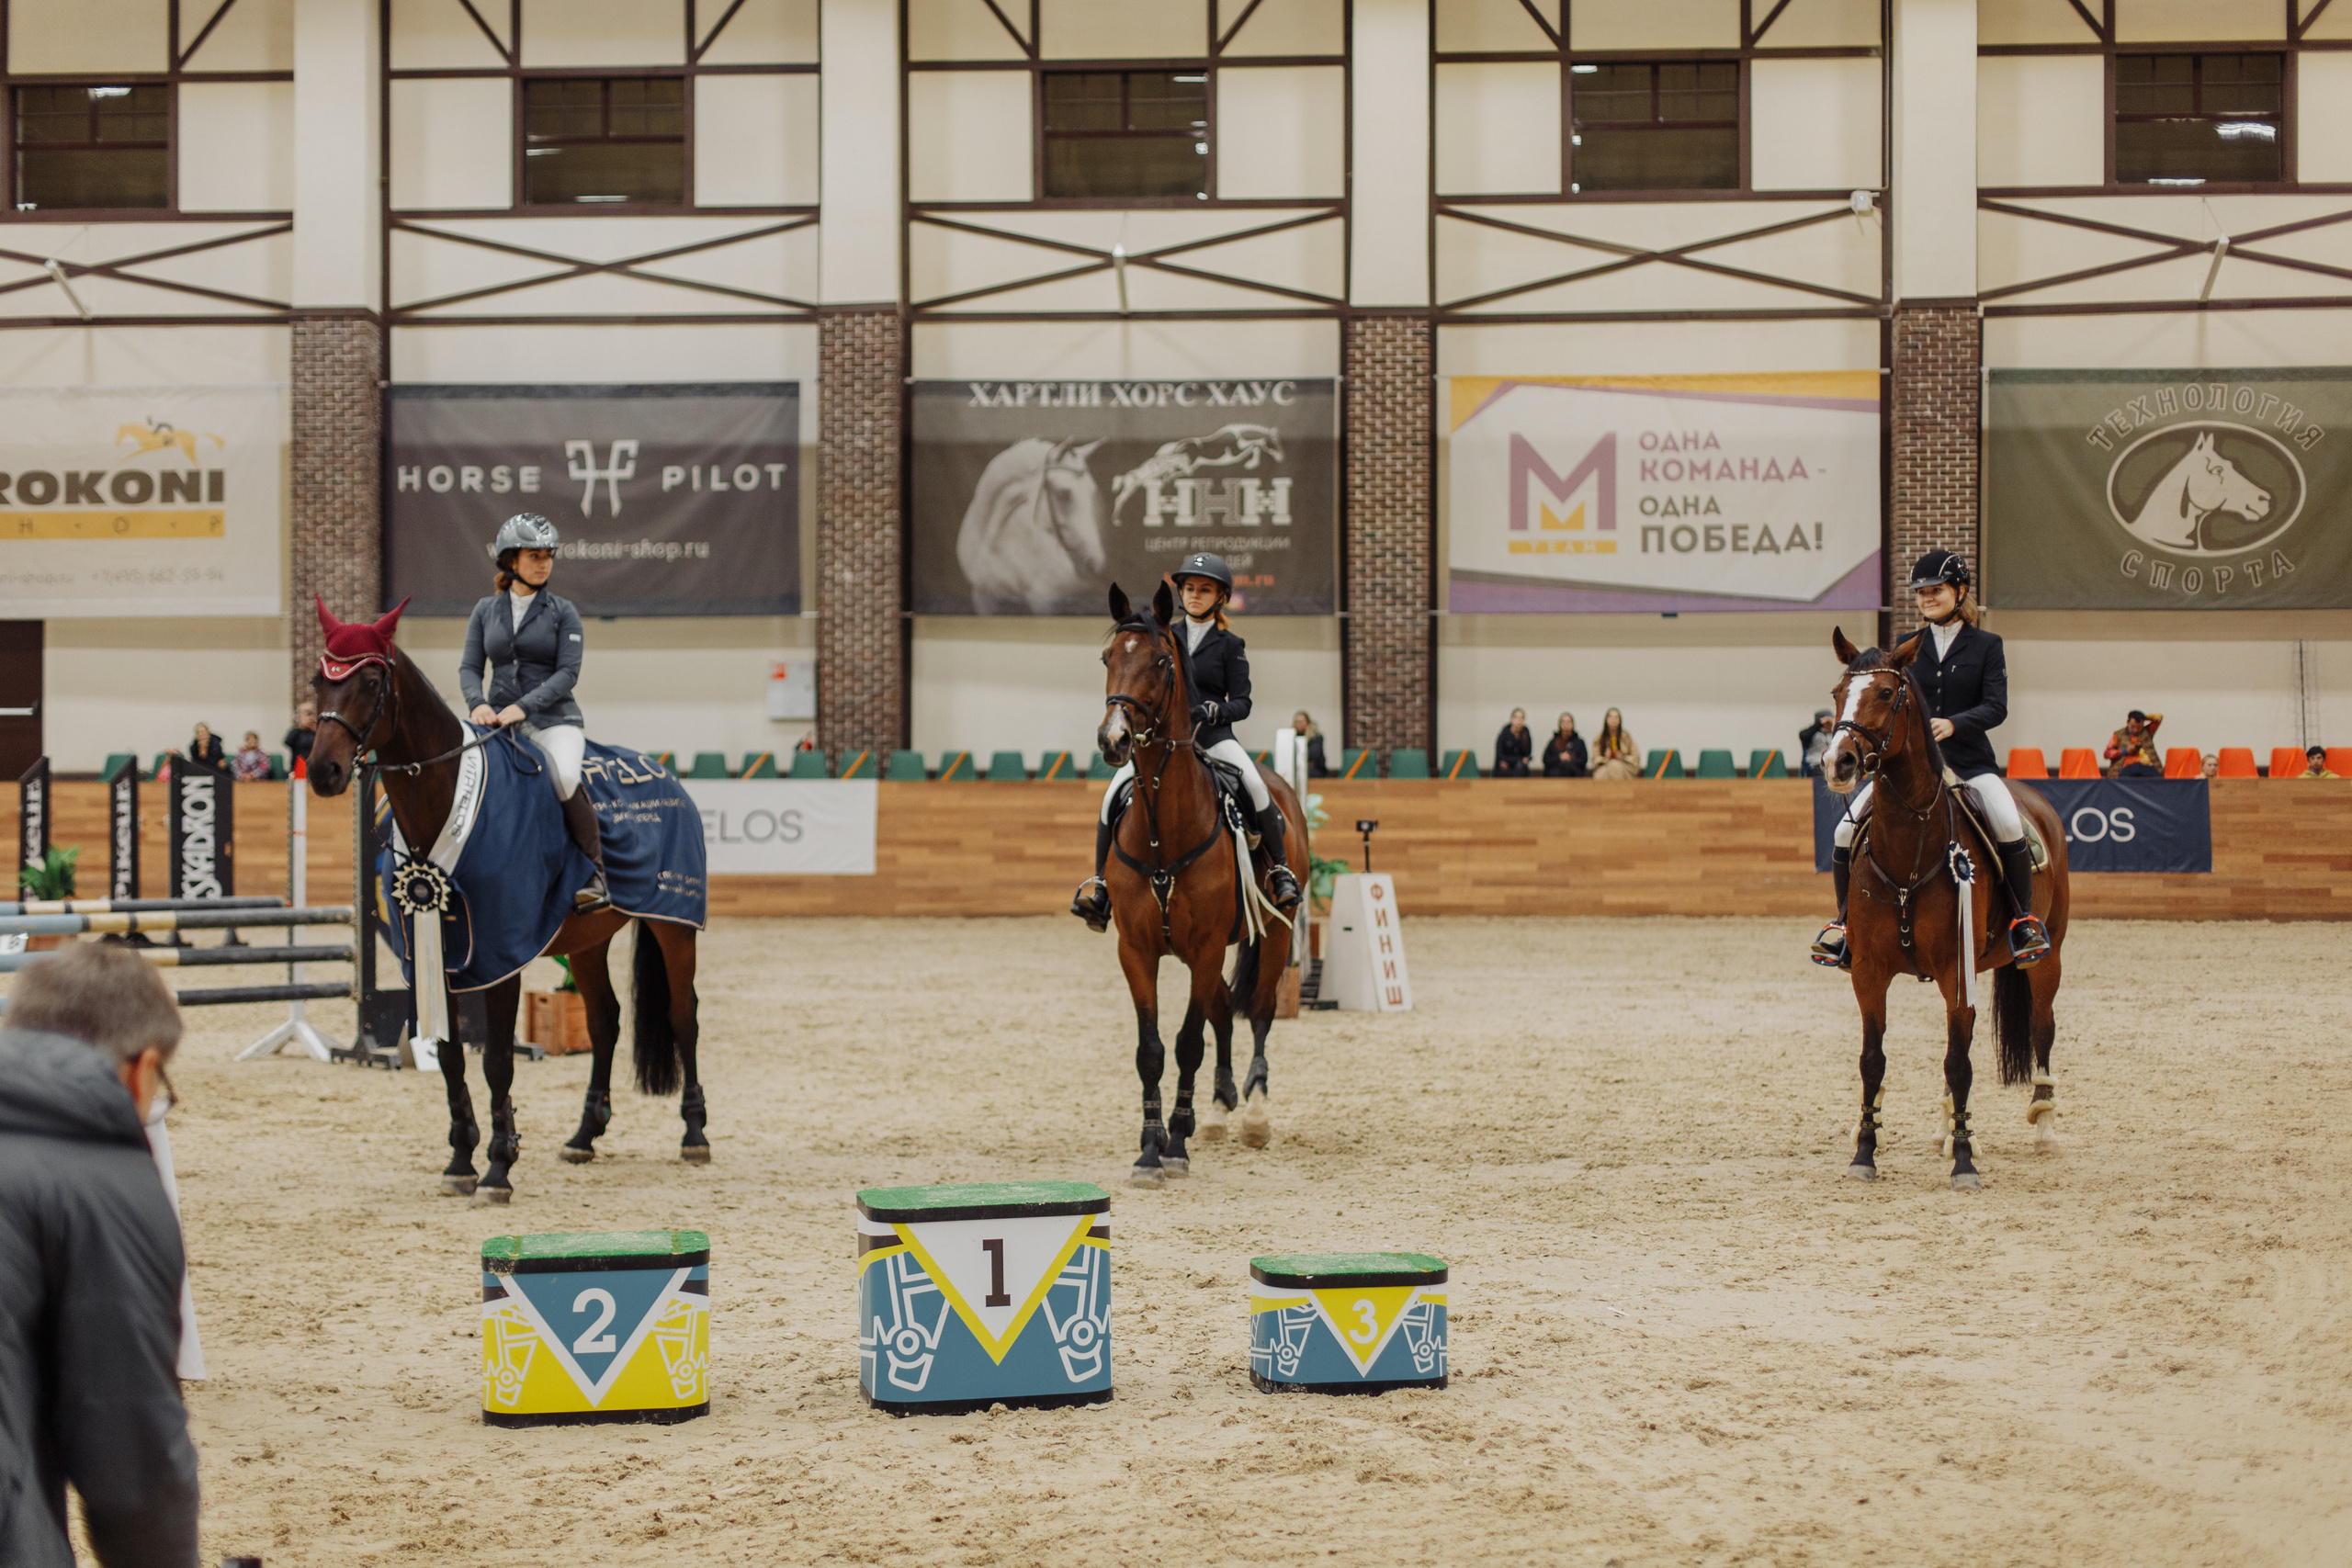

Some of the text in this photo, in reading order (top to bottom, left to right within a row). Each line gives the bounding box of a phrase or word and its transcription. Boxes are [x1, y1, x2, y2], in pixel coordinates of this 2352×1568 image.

[967, 380, 1297, 408] ХАРТЛИ ХОРС ХАУС
[2086, 382, 2325, 452] ТЕХНОЛОГИЯ
[1639, 431, 1722, 453] ОДНА
[0, 469, 224, 505] OKONI
[397, 463, 787, 493] HORSE PILOT
[1640, 457, 1809, 482] КОМАНДА
[1639, 495, 1722, 517] ОДНА
[1641, 522, 1824, 555] ПОБЕДА!
[2120, 548, 2295, 595] СПОРТА
[2065, 807, 2136, 843] OS
[1371, 884, 1402, 1005] ФИНИШ
[981, 1239, 1012, 1307] 1
[571, 1288, 616, 1355] 2
[1348, 1298, 1378, 1343] 3
